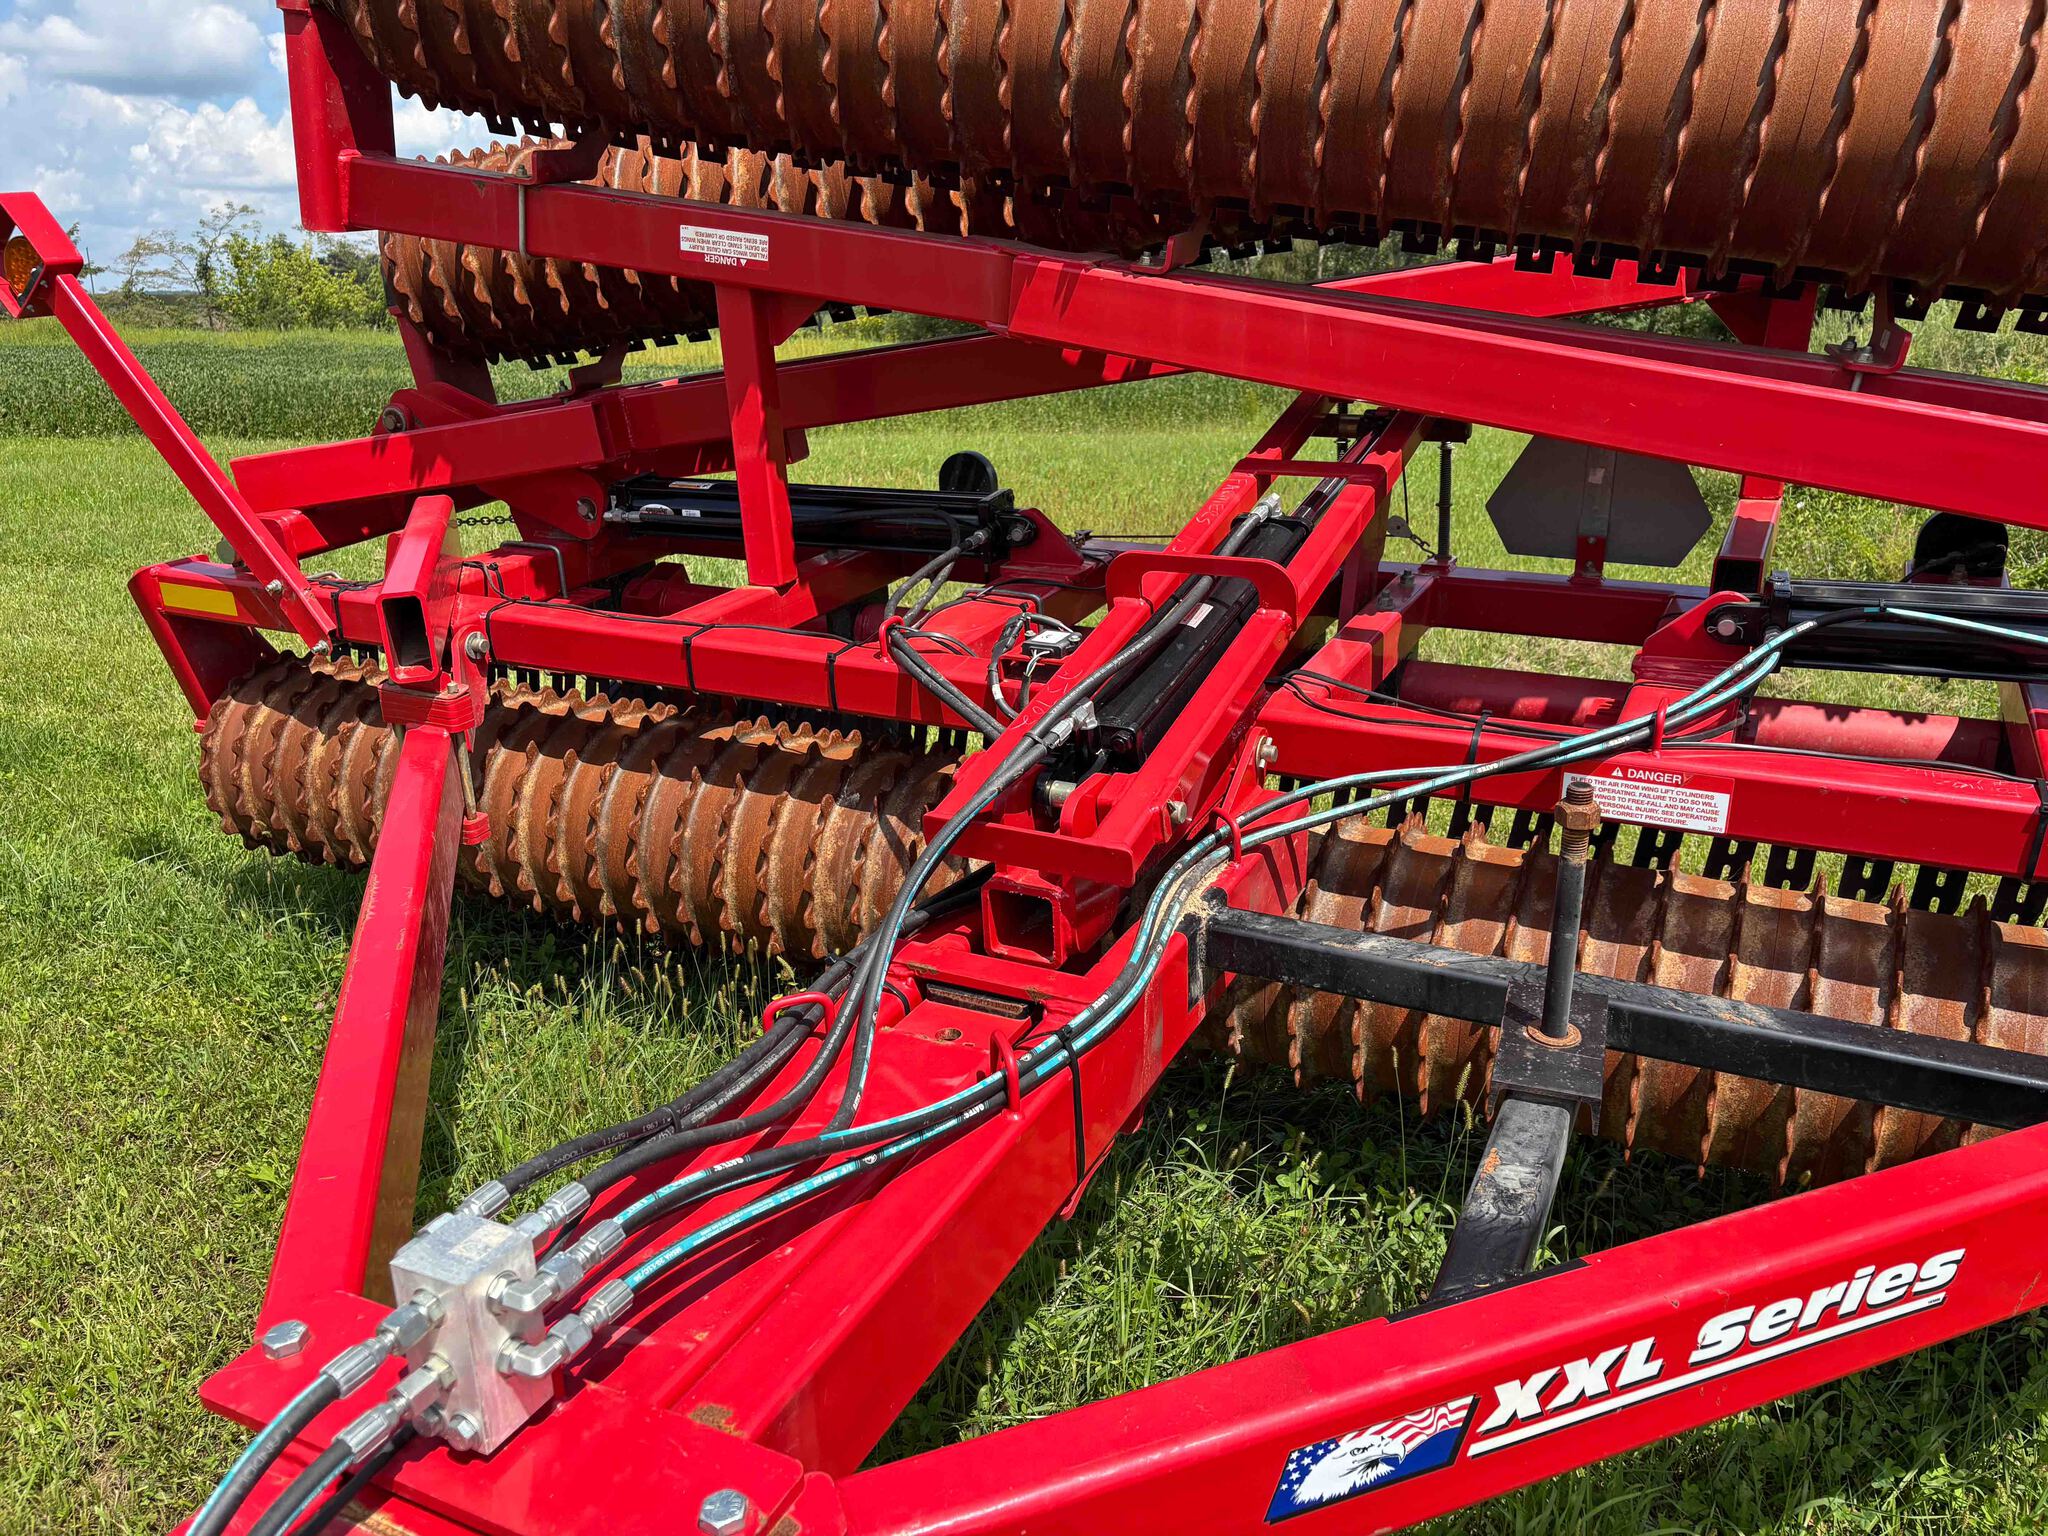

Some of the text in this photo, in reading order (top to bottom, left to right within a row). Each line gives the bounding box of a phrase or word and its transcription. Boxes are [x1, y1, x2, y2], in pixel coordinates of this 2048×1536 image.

[695, 231, 718, 240] LOWERED
[726, 235, 742, 243] RAISED
[706, 246, 722, 254] CAUSE
[712, 240, 726, 248] CLEAR
[728, 242, 742, 250] STAND
[732, 249, 748, 257] WINGS
[749, 251, 768, 260] FALLING
[704, 254, 737, 266] DANGER
[1627, 768, 1682, 785] DANGER
[1598, 787, 1637, 796] OPERATING.
[1639, 792, 1667, 801] FAILURE
[1620, 782, 1640, 791] FROM
[1676, 790, 1715, 800] CYLINDERS
[1599, 801, 1634, 811] PERSONAL
[1635, 806, 1660, 815] INJURY.
[1676, 812, 1718, 823] OPERATORS
[1628, 797, 1664, 808] FREE-FALL
[1696, 807, 1720, 816] CAUSE
[1612, 810, 1643, 820] CORRECT
[1644, 815, 1688, 826] PROCEDURE.
[1476, 1248, 1967, 1436] XXL Series
